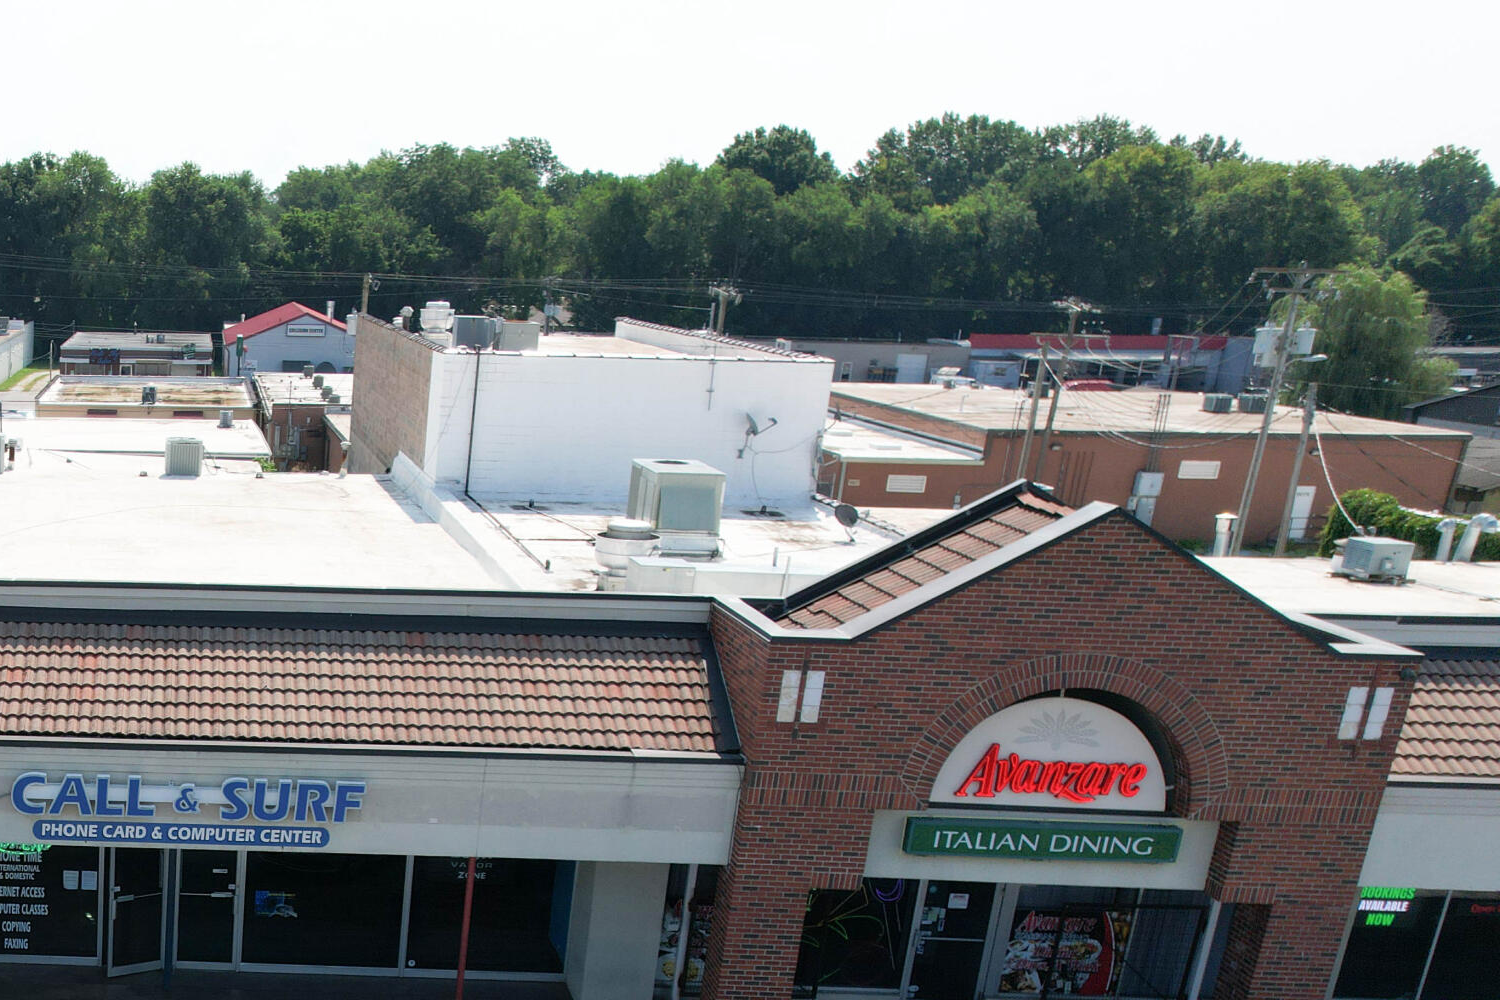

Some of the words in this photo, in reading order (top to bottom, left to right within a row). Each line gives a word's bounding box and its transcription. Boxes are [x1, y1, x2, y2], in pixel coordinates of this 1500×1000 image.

[954, 743, 1148, 804] Avanzare
[11, 772, 156, 817] CALL
[173, 783, 200, 814] &
[220, 777, 367, 823] SURF
[41, 823, 98, 839] PHONE
[102, 824, 147, 840] CARD
[151, 828, 163, 841] &
[168, 826, 256, 843] COMPUTER
[260, 829, 323, 844] CENTER
[933, 831, 1040, 851] ITALIAN
[1050, 834, 1155, 856] DINING
[23, 851, 42, 863] TIME
[451, 861, 493, 869] VAOR
[0, 872, 3, 880] &
[5, 872, 35, 880] DOMESTIC
[20, 886, 45, 898] ACCESS
[1361, 887, 1415, 898] BOOKINGS
[21, 903, 49, 916] CLASSES
[1358, 900, 1409, 911] AVAILABLE
[1365, 913, 1395, 925] NOW
[2, 920, 31, 933] COPYING
[4, 938, 29, 950] FAXING
